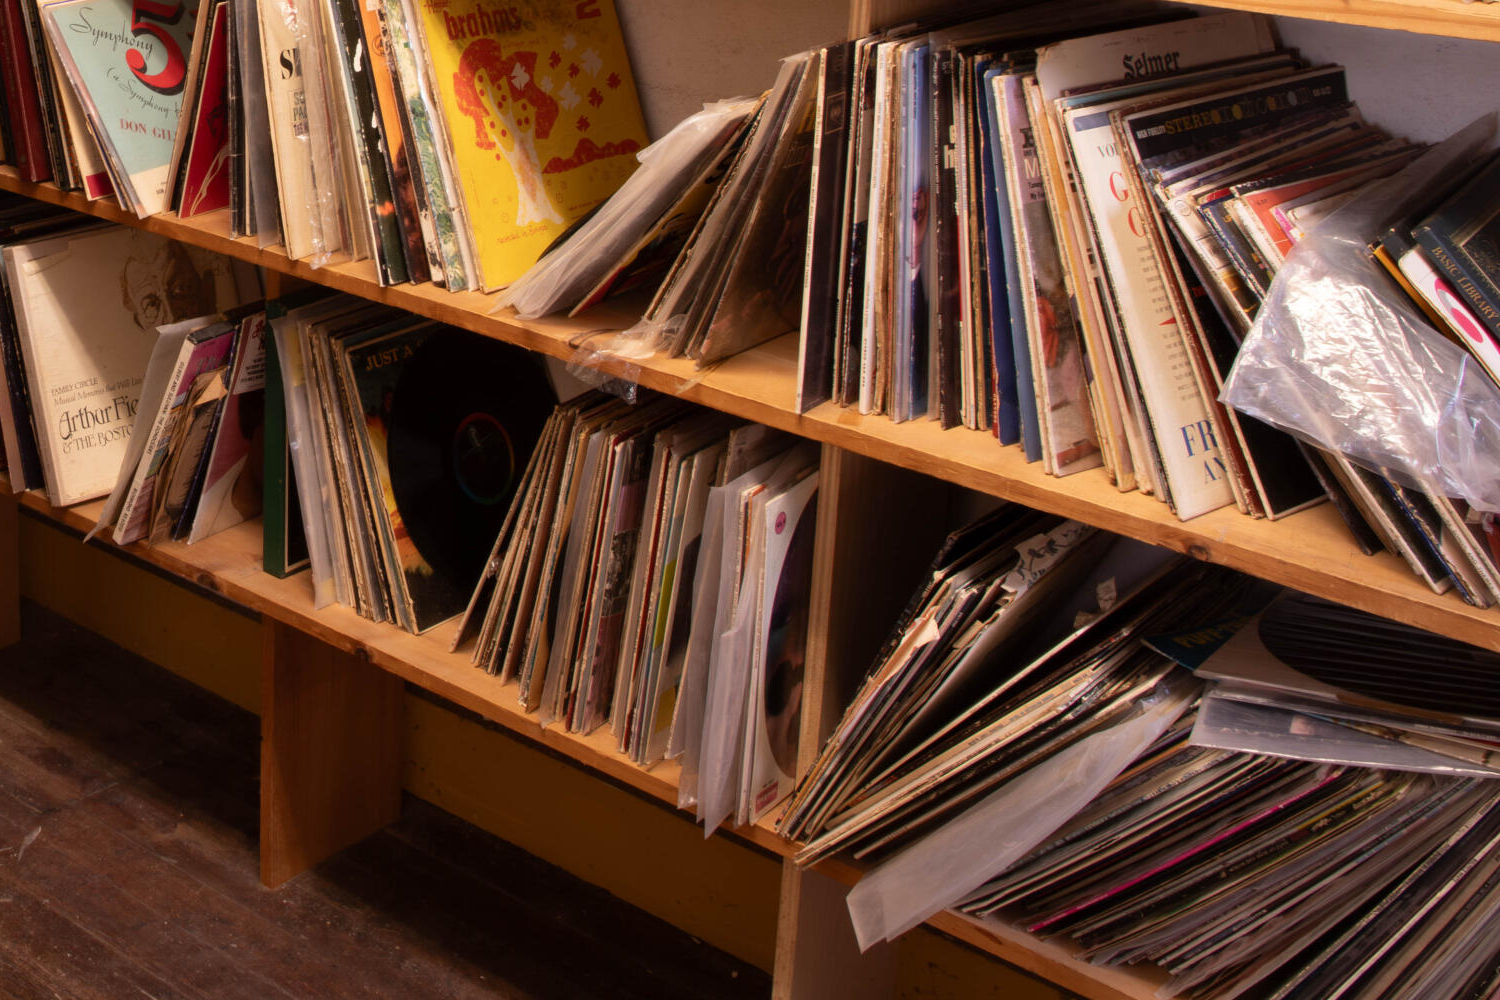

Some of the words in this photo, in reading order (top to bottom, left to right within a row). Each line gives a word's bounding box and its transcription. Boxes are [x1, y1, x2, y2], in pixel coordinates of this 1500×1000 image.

[68, 6, 154, 59] Symphony
[443, 3, 522, 42] brahms
[1122, 51, 1181, 81] Selmer
[119, 79, 171, 119] Symphony
[119, 117, 147, 137] DON
[1431, 246, 1461, 277] BASIC
[1457, 274, 1500, 320] LIBRARY
[365, 347, 400, 372] JUST
[403, 343, 413, 361] A
[51, 383, 74, 396] FAMILY
[74, 377, 99, 389] CIRCLE
[117, 378, 131, 389] Will
[169, 379, 178, 392] AND
[59, 405, 112, 441] Arthur
[157, 414, 165, 425] THE
[73, 433, 97, 452] THE
